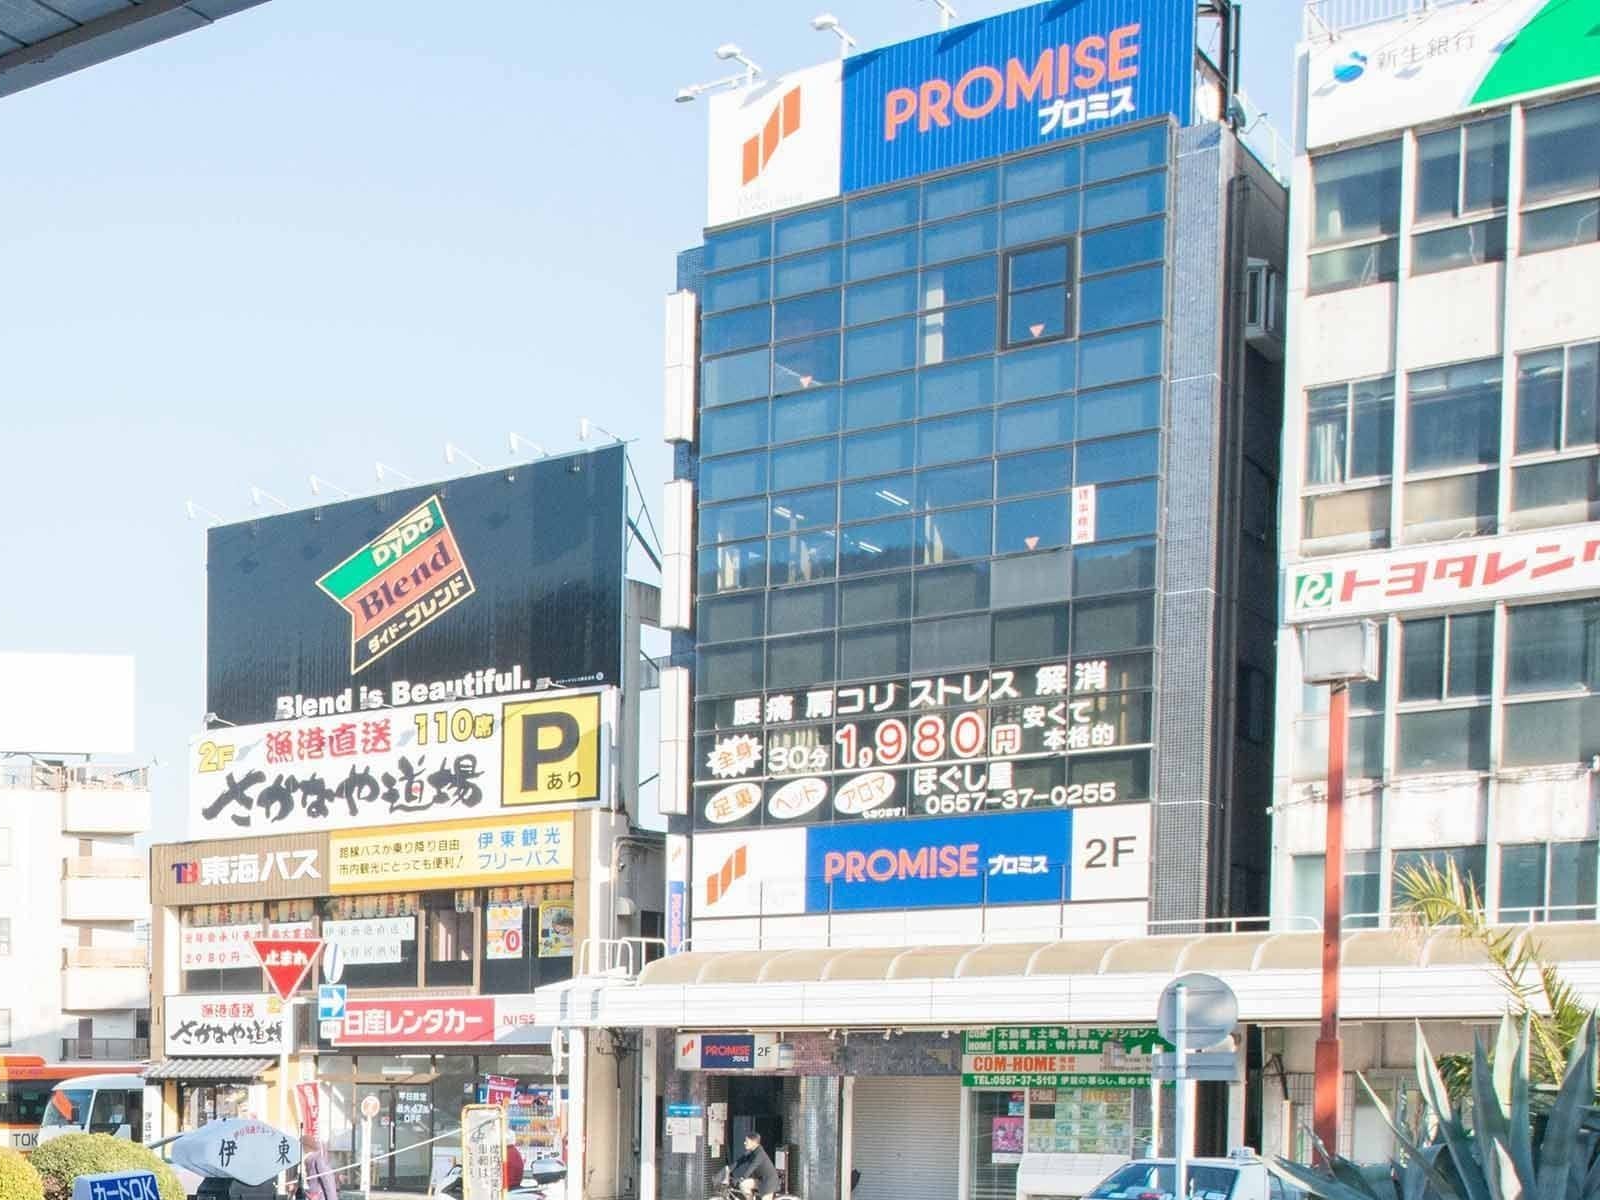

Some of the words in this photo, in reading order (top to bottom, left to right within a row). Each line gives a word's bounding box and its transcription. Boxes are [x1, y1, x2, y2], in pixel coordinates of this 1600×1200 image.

[1376, 34, 1476, 71] 新生銀行
[885, 23, 1141, 141] PROMISE
[1039, 86, 1135, 135] プロミス
[371, 512, 434, 567] DyDo
[357, 541, 455, 622] Blend
[368, 575, 467, 655] ダイドーブレンド
[276, 688, 353, 720] Blend
[359, 686, 383, 711] is
[391, 665, 531, 705] Beautiful.
[733, 694, 794, 725] 腰痛
[806, 681, 896, 720] 肩コリ
[910, 672, 1018, 709] ストレス
[1034, 661, 1108, 696] 解消
[1023, 699, 1092, 728] 安くて
[198, 741, 236, 773] 2F
[265, 718, 392, 765] 漁港直送
[414, 708, 495, 745] 110席
[520, 711, 581, 792] P
[716, 738, 753, 771] 全身
[767, 745, 829, 772] 30分
[1043, 723, 1115, 752] 本格的
[201, 752, 486, 827] さかなや道場
[546, 770, 582, 792] あり
[844, 776, 889, 810] アロマ
[913, 765, 1014, 796] ほぐし屋
[926, 781, 1117, 814] 0557-37-0255
[477, 827, 561, 849] 伊東観光
[200, 849, 323, 886] 東海バス
[824, 843, 979, 883] PROMISE
[988, 853, 1050, 877] プロミス
[1084, 836, 1138, 869] 2F
[264, 949, 310, 967] 止まれ
[344, 1008, 484, 1036] 日産レンタカー
[705, 1044, 752, 1057] PROMISE
[757, 1047, 772, 1057] 2F
[973, 1056, 1057, 1072] COM-HOME
[218, 1136, 292, 1168] 伊東
